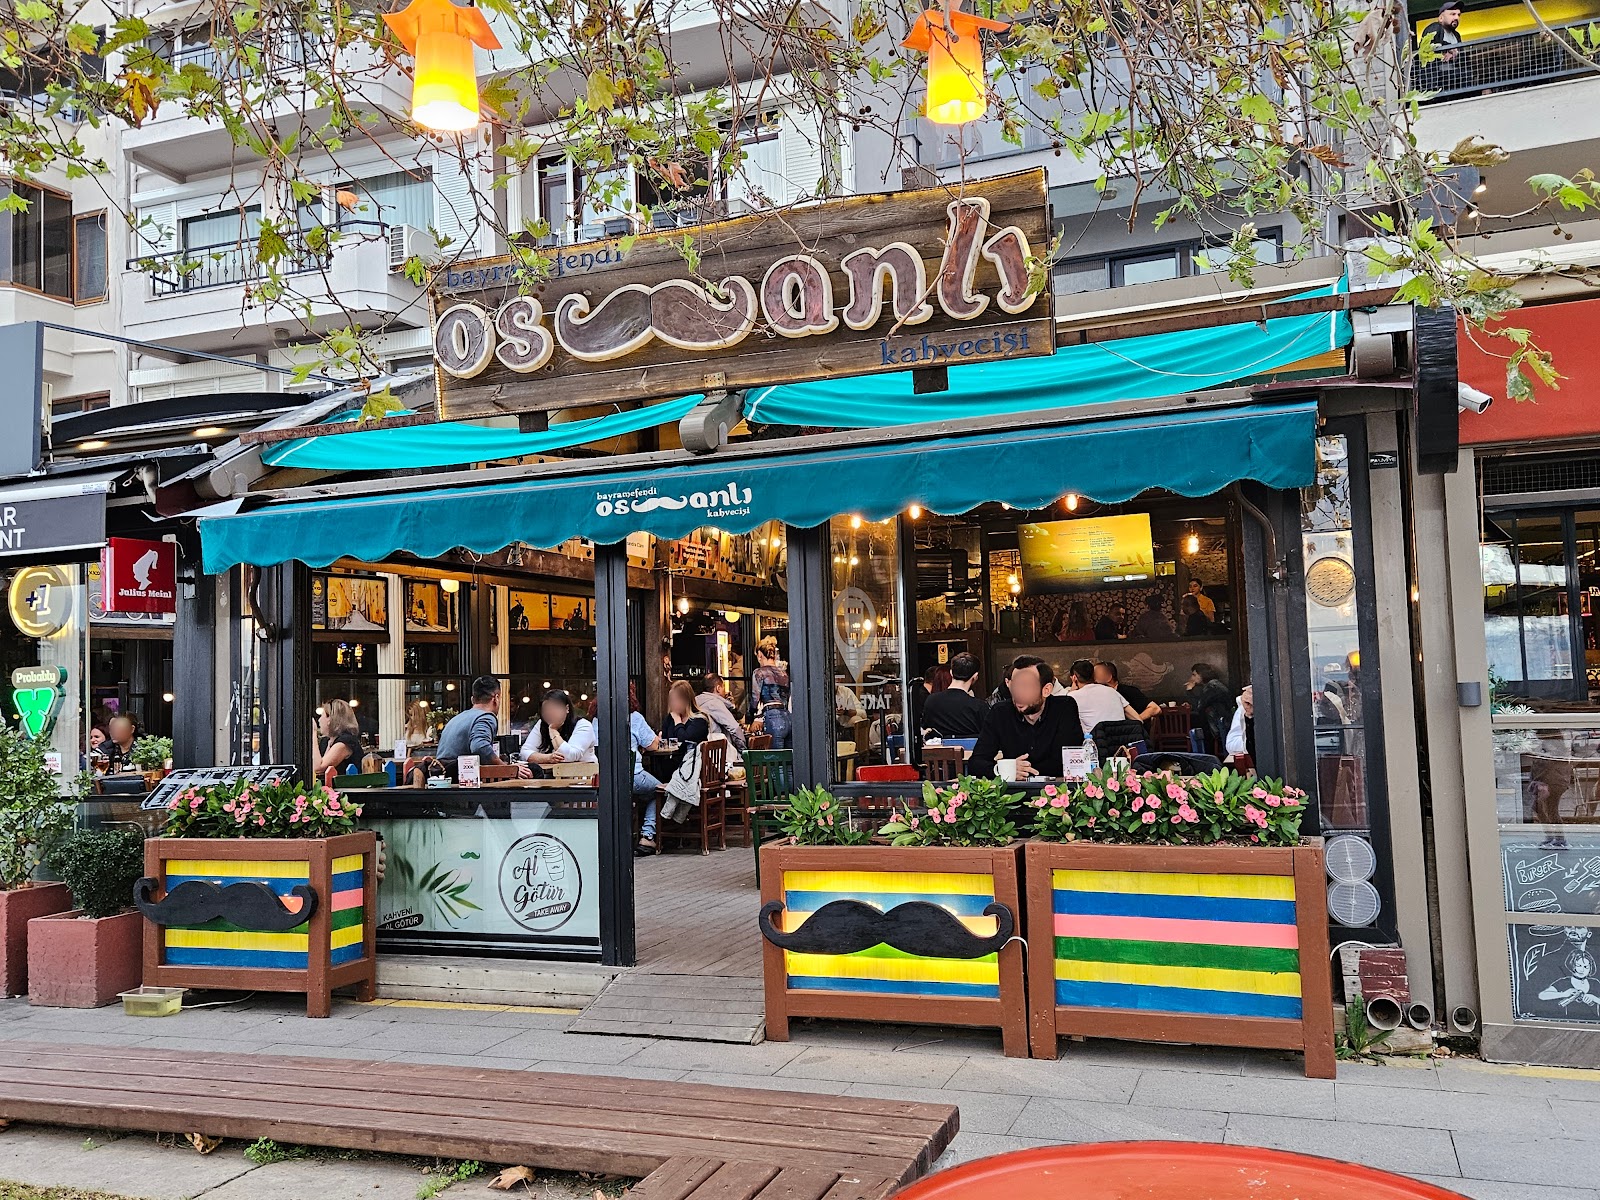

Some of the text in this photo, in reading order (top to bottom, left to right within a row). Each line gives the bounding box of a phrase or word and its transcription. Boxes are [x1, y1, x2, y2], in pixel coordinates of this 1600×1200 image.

[596, 487, 658, 501] bayramefendi
[0, 506, 16, 527] R
[118, 588, 172, 598] Julius Meinl
[16, 670, 56, 684] Probably
[512, 854, 538, 887] Al
[513, 881, 565, 913] Götür
[383, 905, 413, 921] KAHVENİ
[534, 904, 567, 917] TAKE AWAY
